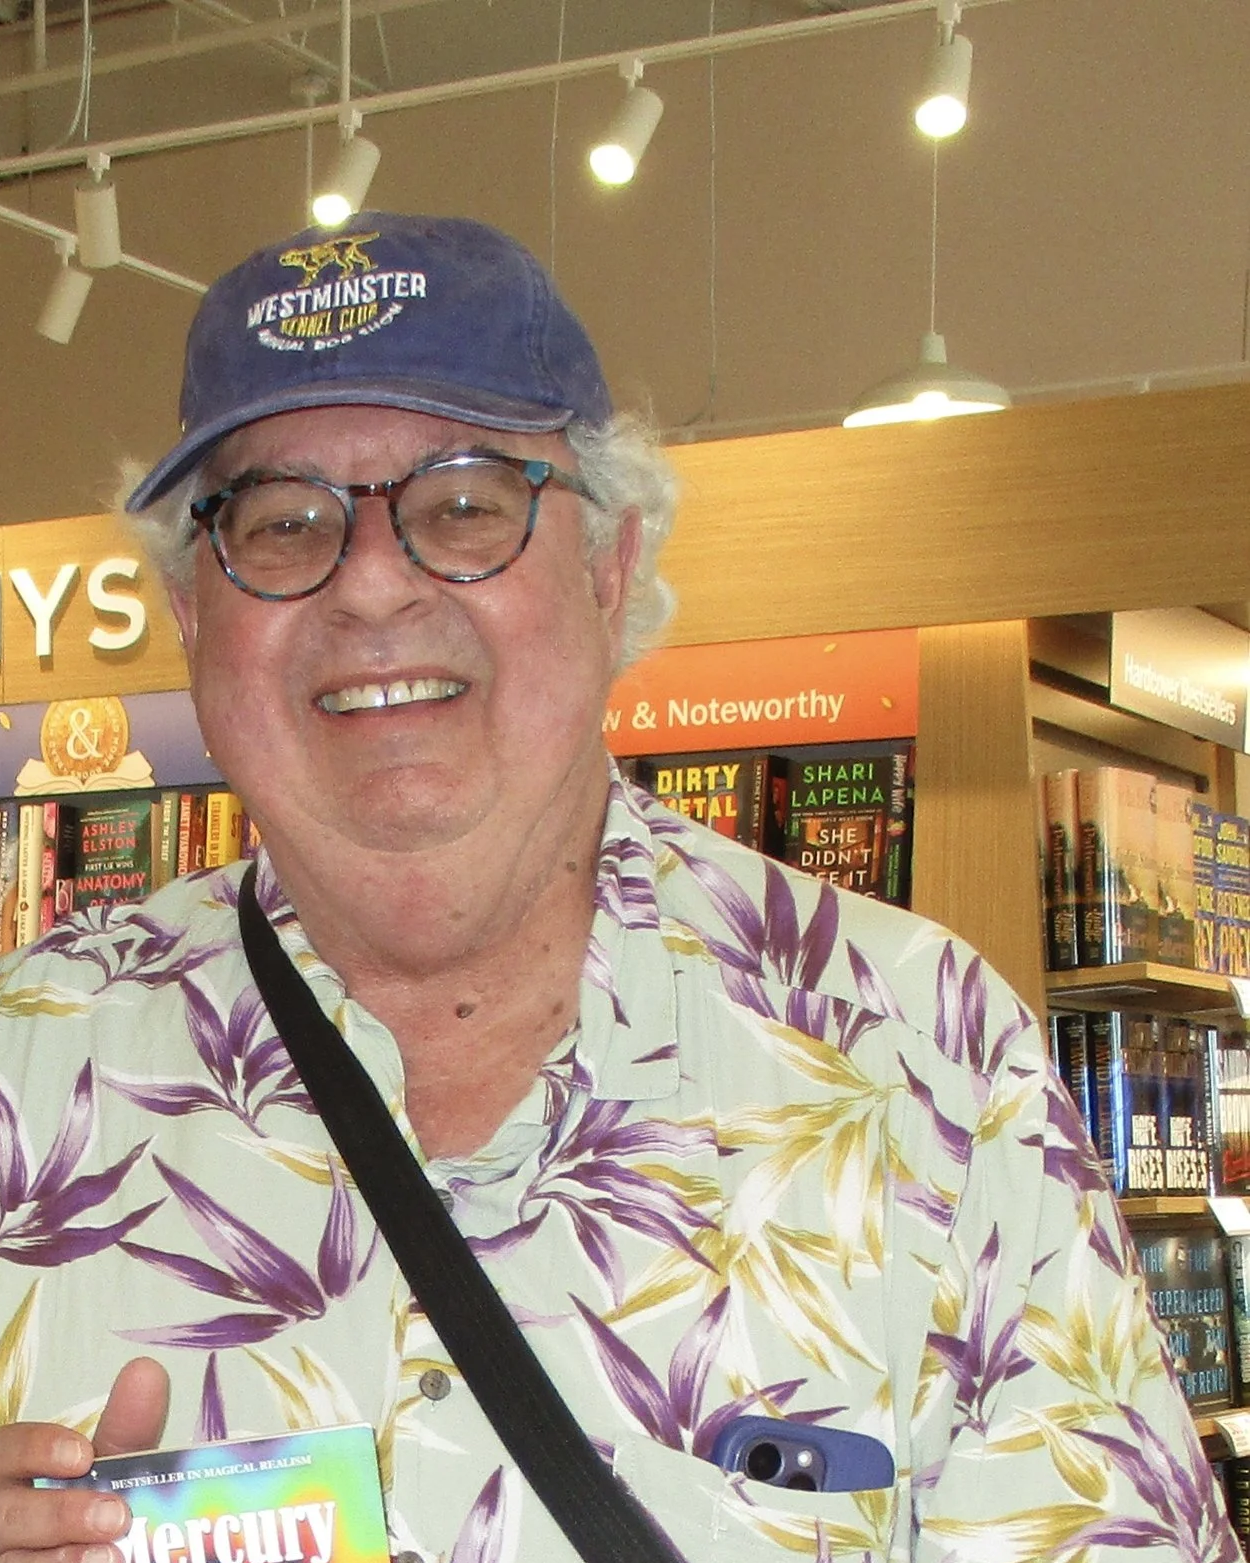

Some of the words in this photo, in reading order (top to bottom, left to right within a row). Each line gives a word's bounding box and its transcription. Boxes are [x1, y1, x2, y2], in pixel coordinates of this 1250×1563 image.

[247, 271, 427, 328] WESTMINSTER
[280, 309, 332, 338] KENNEL
[632, 701, 657, 730] &
[667, 688, 846, 729] Noteworthy
[657, 763, 741, 795] DIRTY
[803, 763, 874, 784] SHARI
[791, 787, 885, 808] LAPENA
[83, 821, 136, 838] ASHLEY
[819, 828, 857, 844] SHE
[83, 837, 136, 853] ELSTON
[178, 830, 190, 876] EVANOVIC
[801, 848, 872, 867] DIDN'T
[77, 872, 146, 892] ANATOMY
[111, 1472, 185, 1490] BESTSELLER
[187, 1470, 201, 1480] IN
[204, 1463, 258, 1478] MAGICAL
[259, 1455, 312, 1470] REALISM
